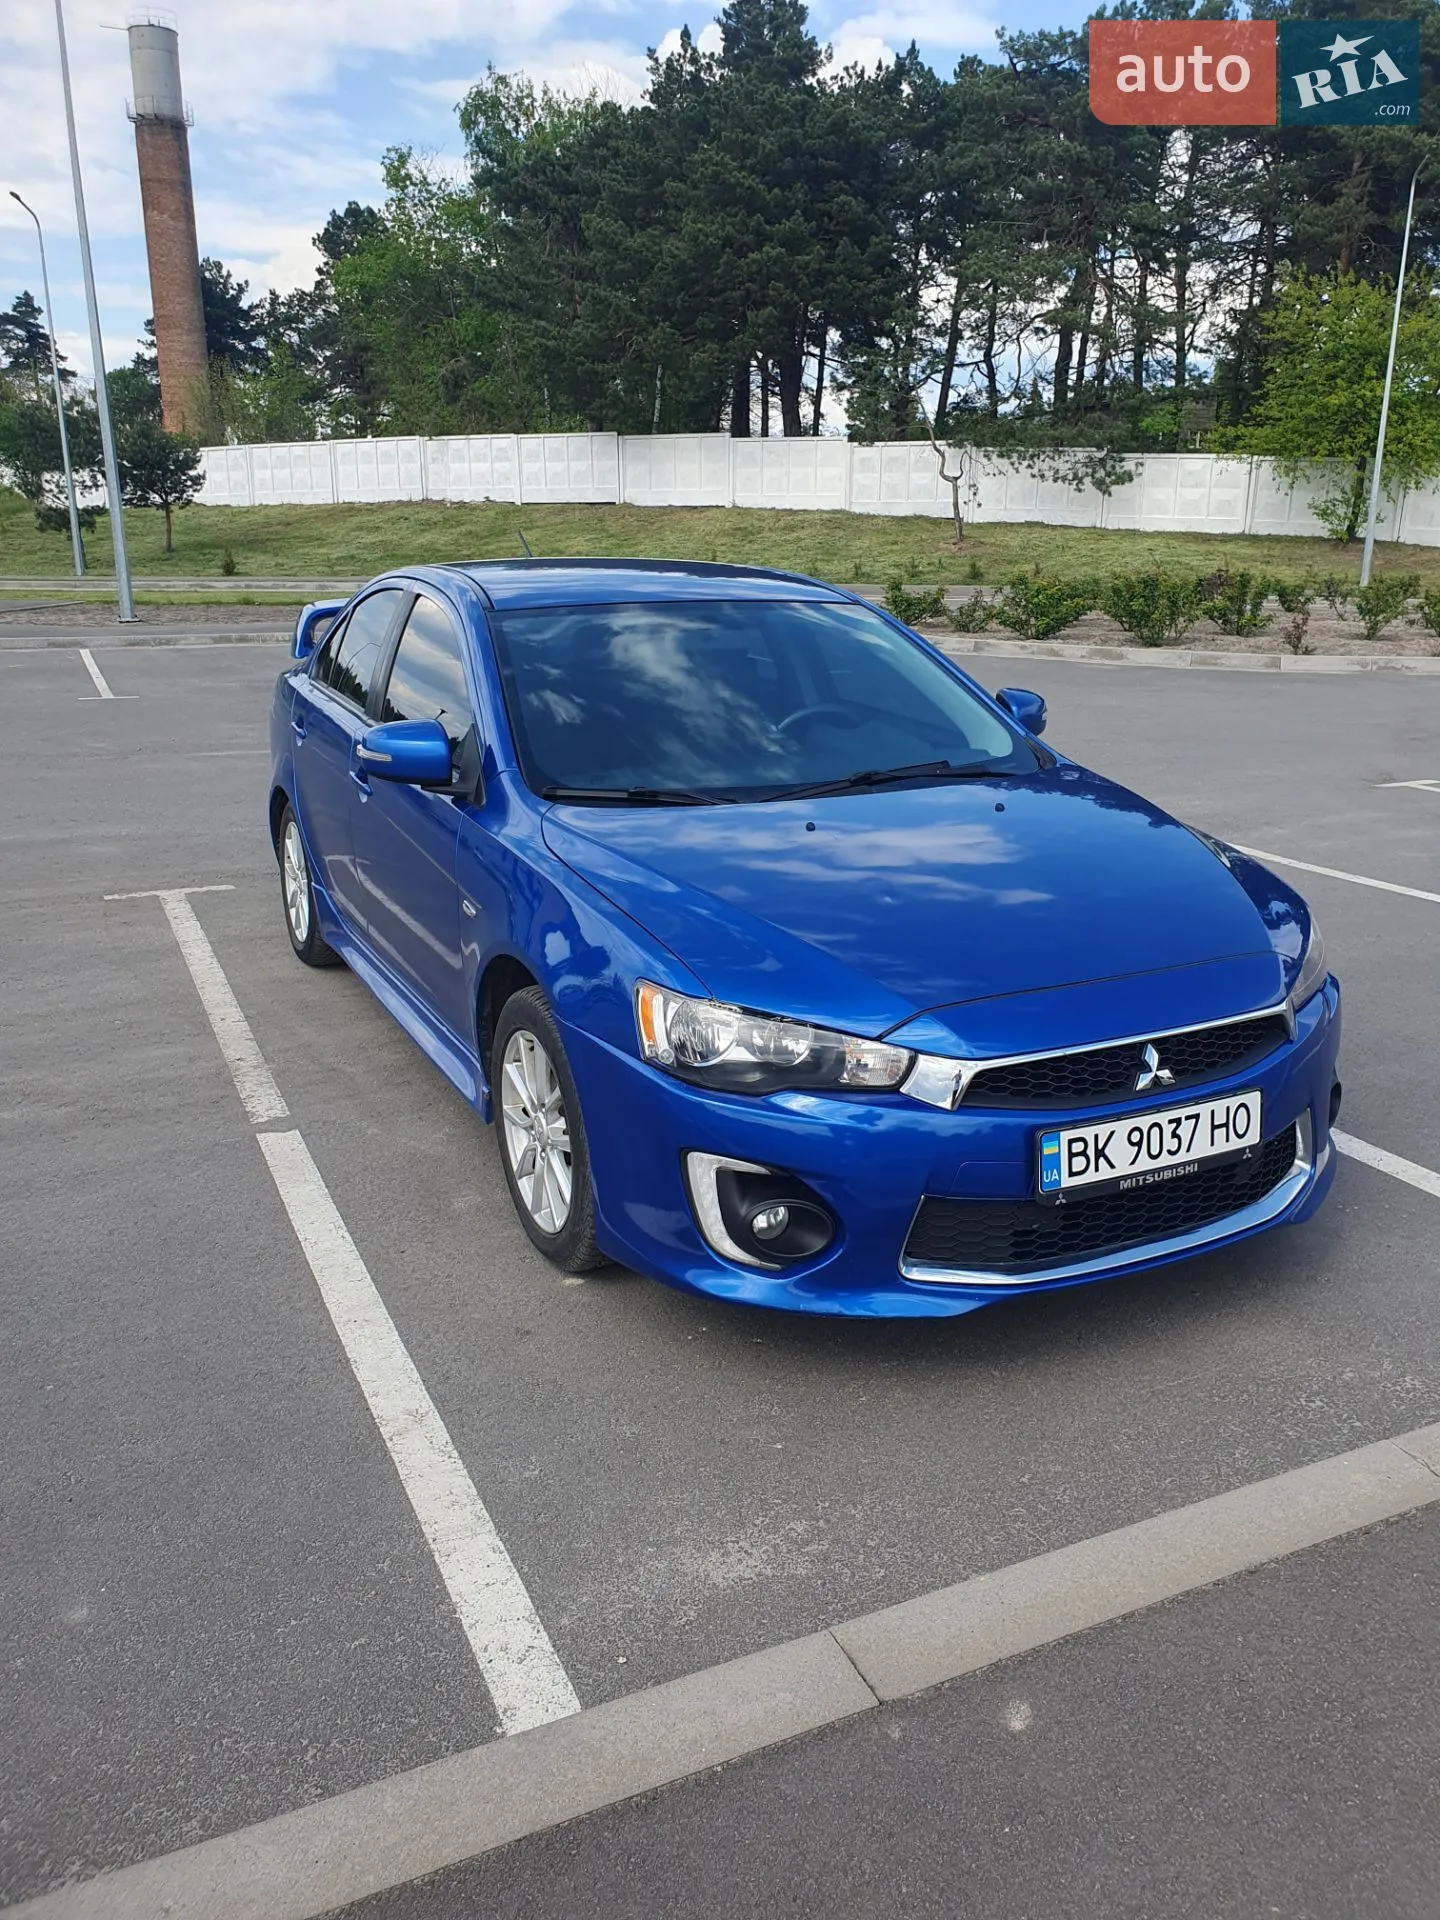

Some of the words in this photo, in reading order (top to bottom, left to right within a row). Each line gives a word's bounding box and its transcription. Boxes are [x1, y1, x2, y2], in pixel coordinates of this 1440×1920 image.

[1067, 1130, 1116, 1178] BK
[1126, 1112, 1201, 1166] 9037
[1209, 1102, 1251, 1147] HO
[1043, 1168, 1060, 1183] UA
[1119, 1163, 1199, 1190] MITSUBISHI
